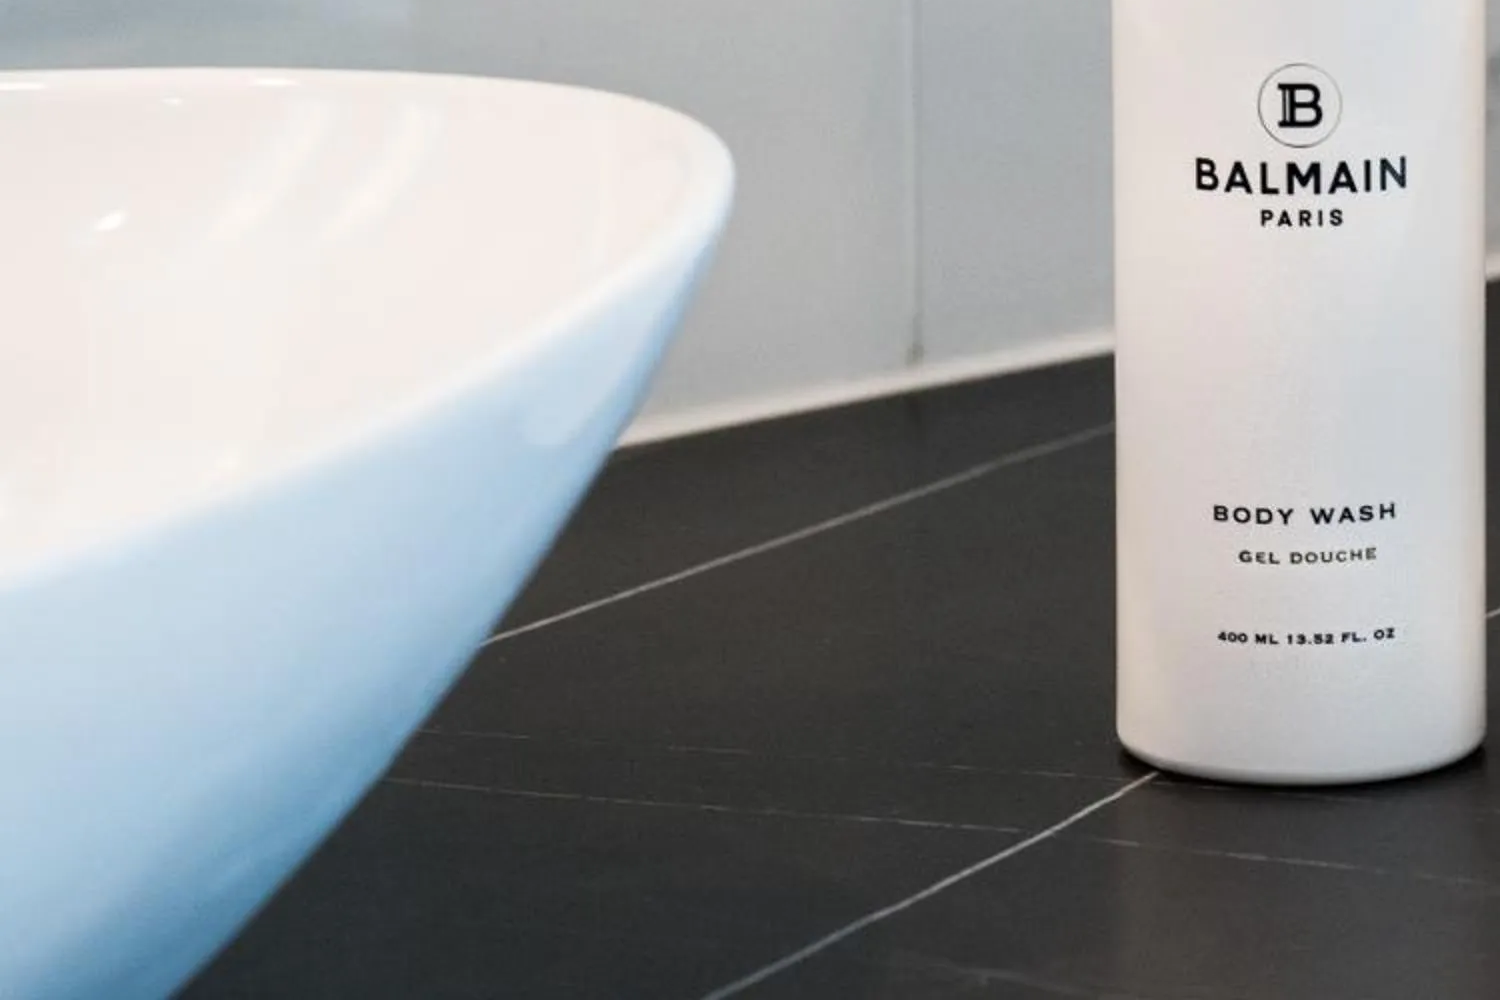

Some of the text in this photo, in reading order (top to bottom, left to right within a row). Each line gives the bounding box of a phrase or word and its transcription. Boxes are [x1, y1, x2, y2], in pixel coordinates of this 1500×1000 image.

[1277, 82, 1324, 129] B
[1194, 155, 1407, 196] BALMAIN
[1260, 207, 1345, 228] PARIS
[1212, 501, 1397, 526] BODY WASH
[1237, 546, 1378, 566] GEL DOUCHE
[1217, 627, 1397, 646] 400 ML 13.52 FL. OZ
